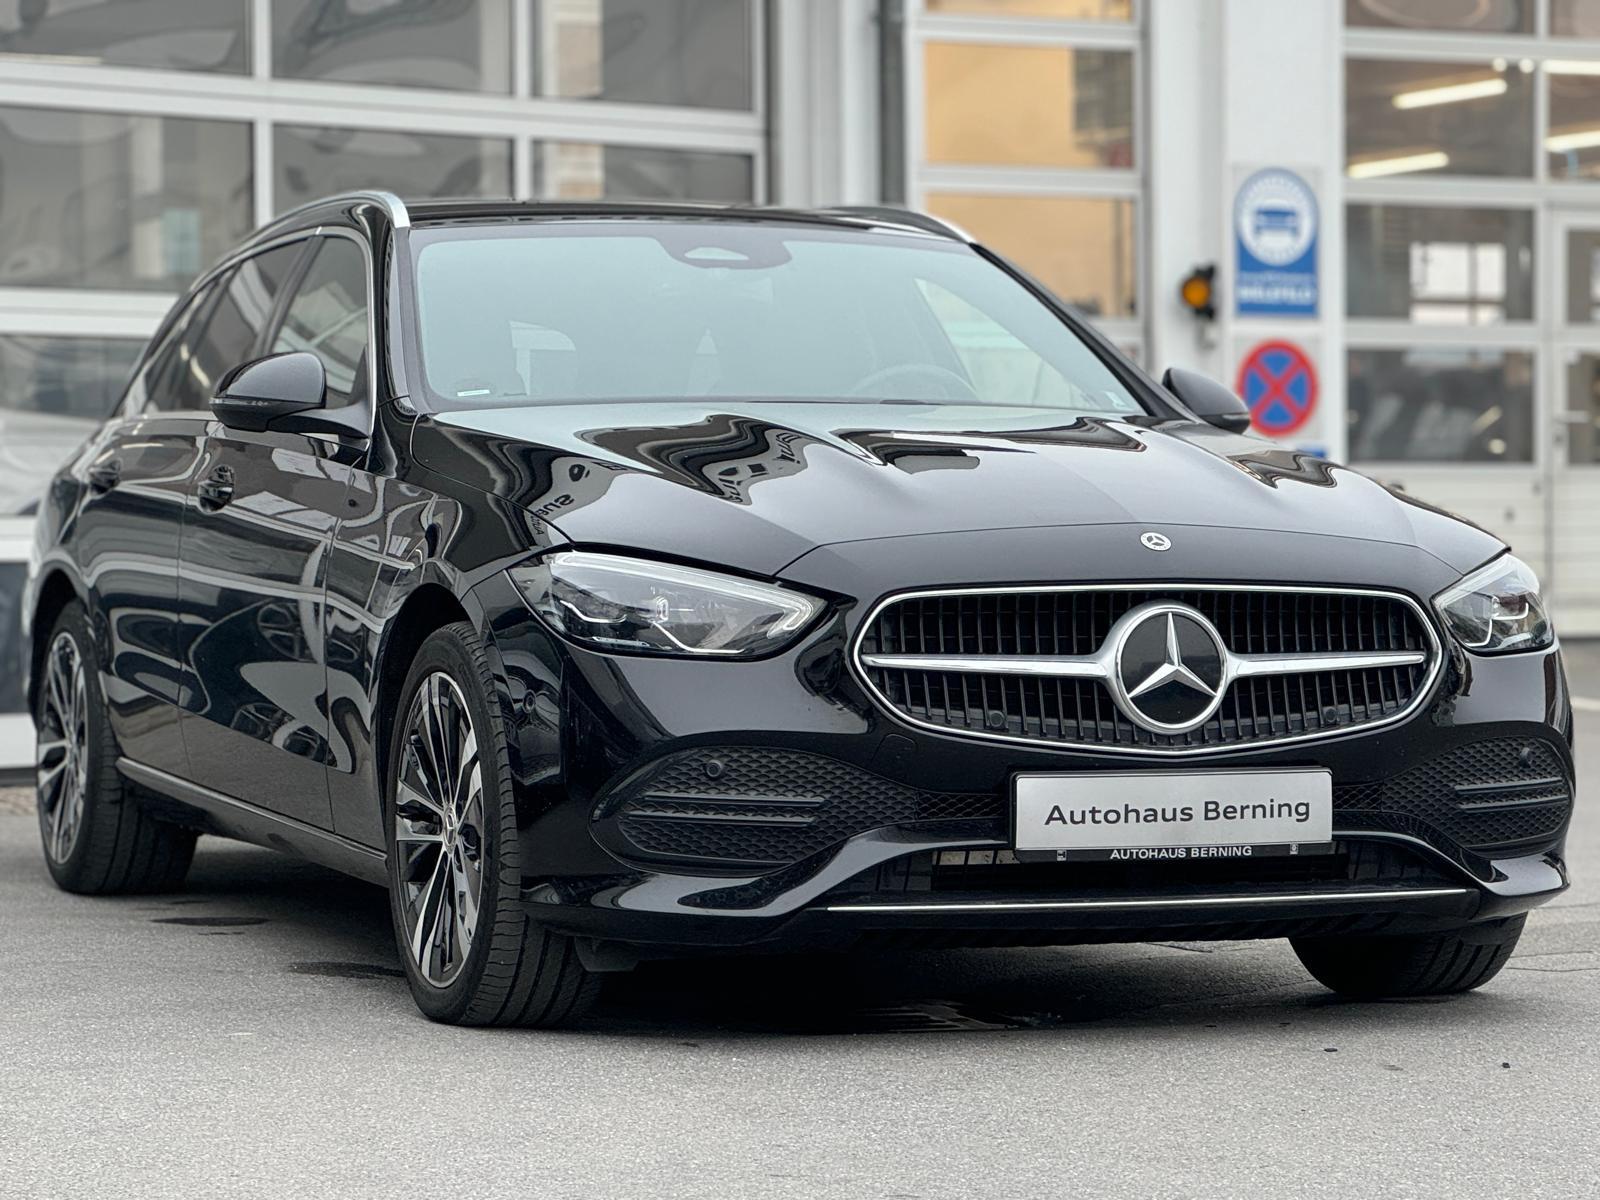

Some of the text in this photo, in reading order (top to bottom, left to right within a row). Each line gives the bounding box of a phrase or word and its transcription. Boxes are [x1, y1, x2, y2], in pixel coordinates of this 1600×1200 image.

[1045, 798, 1310, 826] Autohaus Berning
[1110, 845, 1252, 860] AUTOHAUS BERNING
